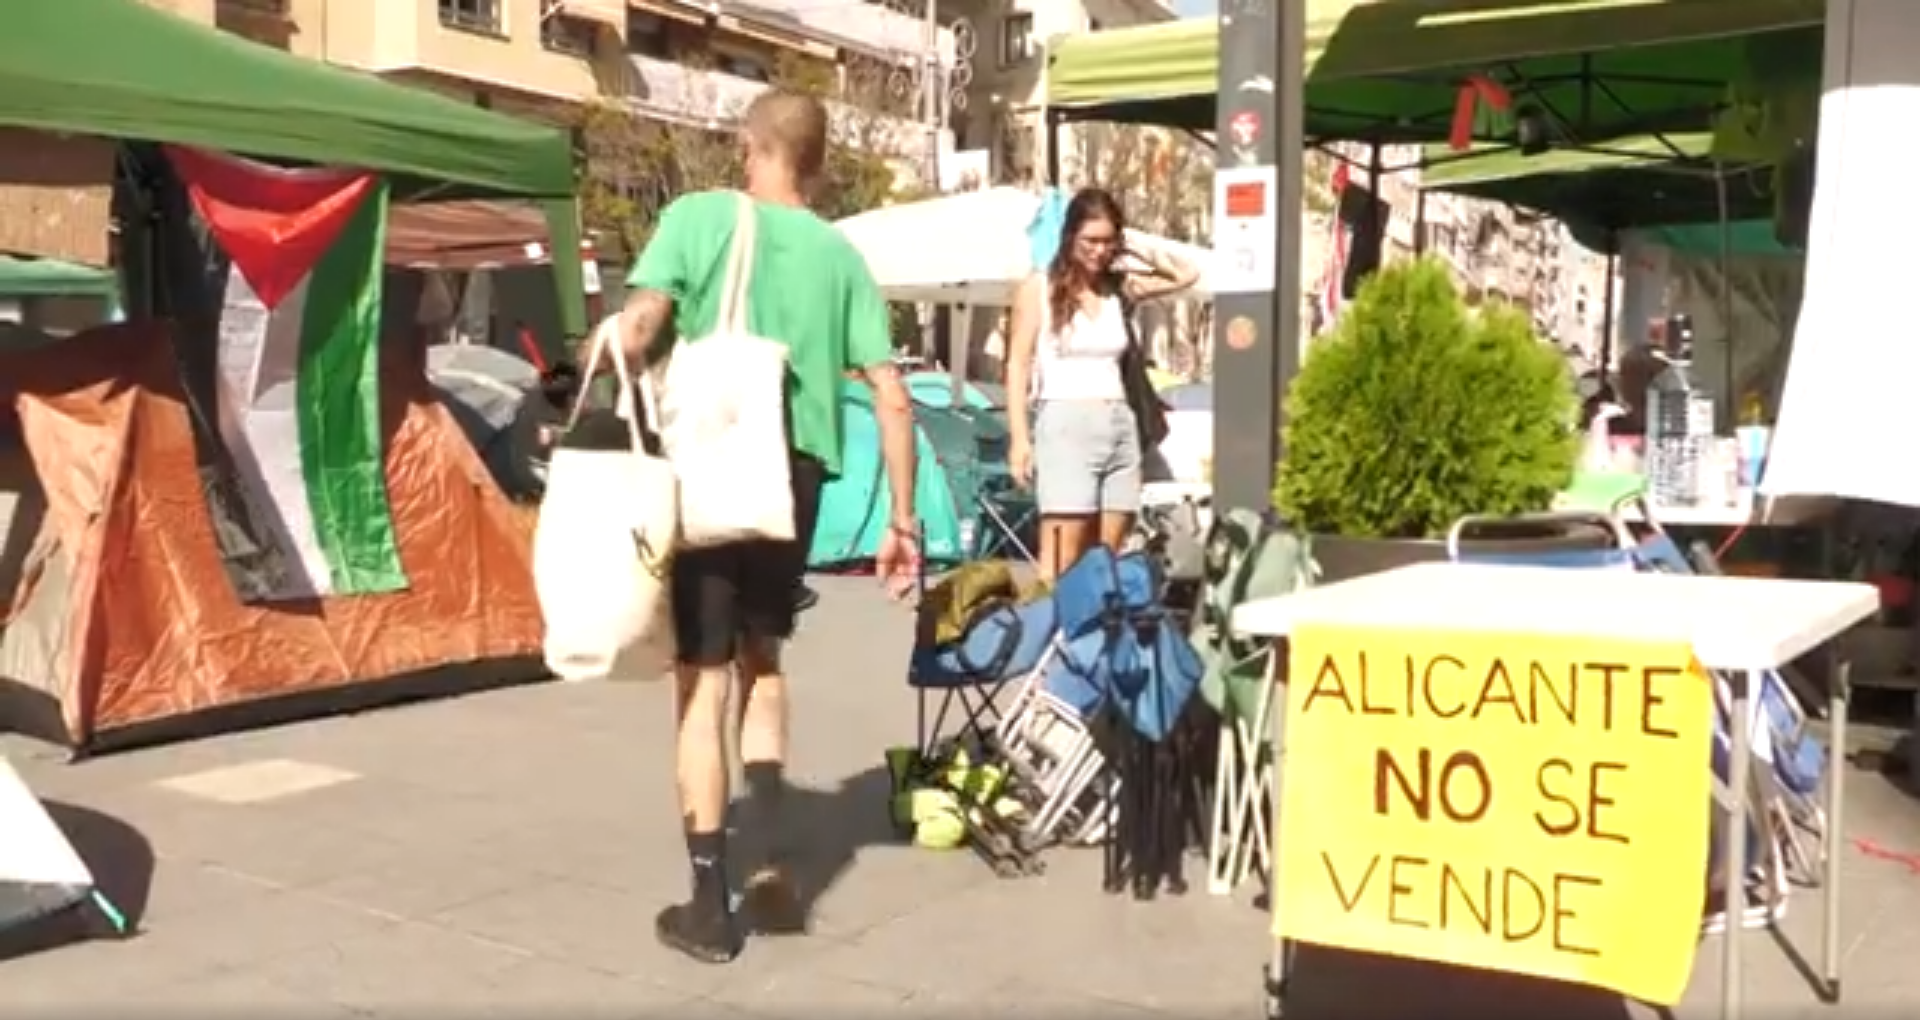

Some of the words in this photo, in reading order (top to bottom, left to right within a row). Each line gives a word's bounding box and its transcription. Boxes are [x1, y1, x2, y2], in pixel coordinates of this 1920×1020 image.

[1303, 651, 1682, 738] ALICANTE
[1375, 748, 1491, 823] NO
[1534, 758, 1630, 844] SE
[1321, 851, 1602, 956] VENDE
